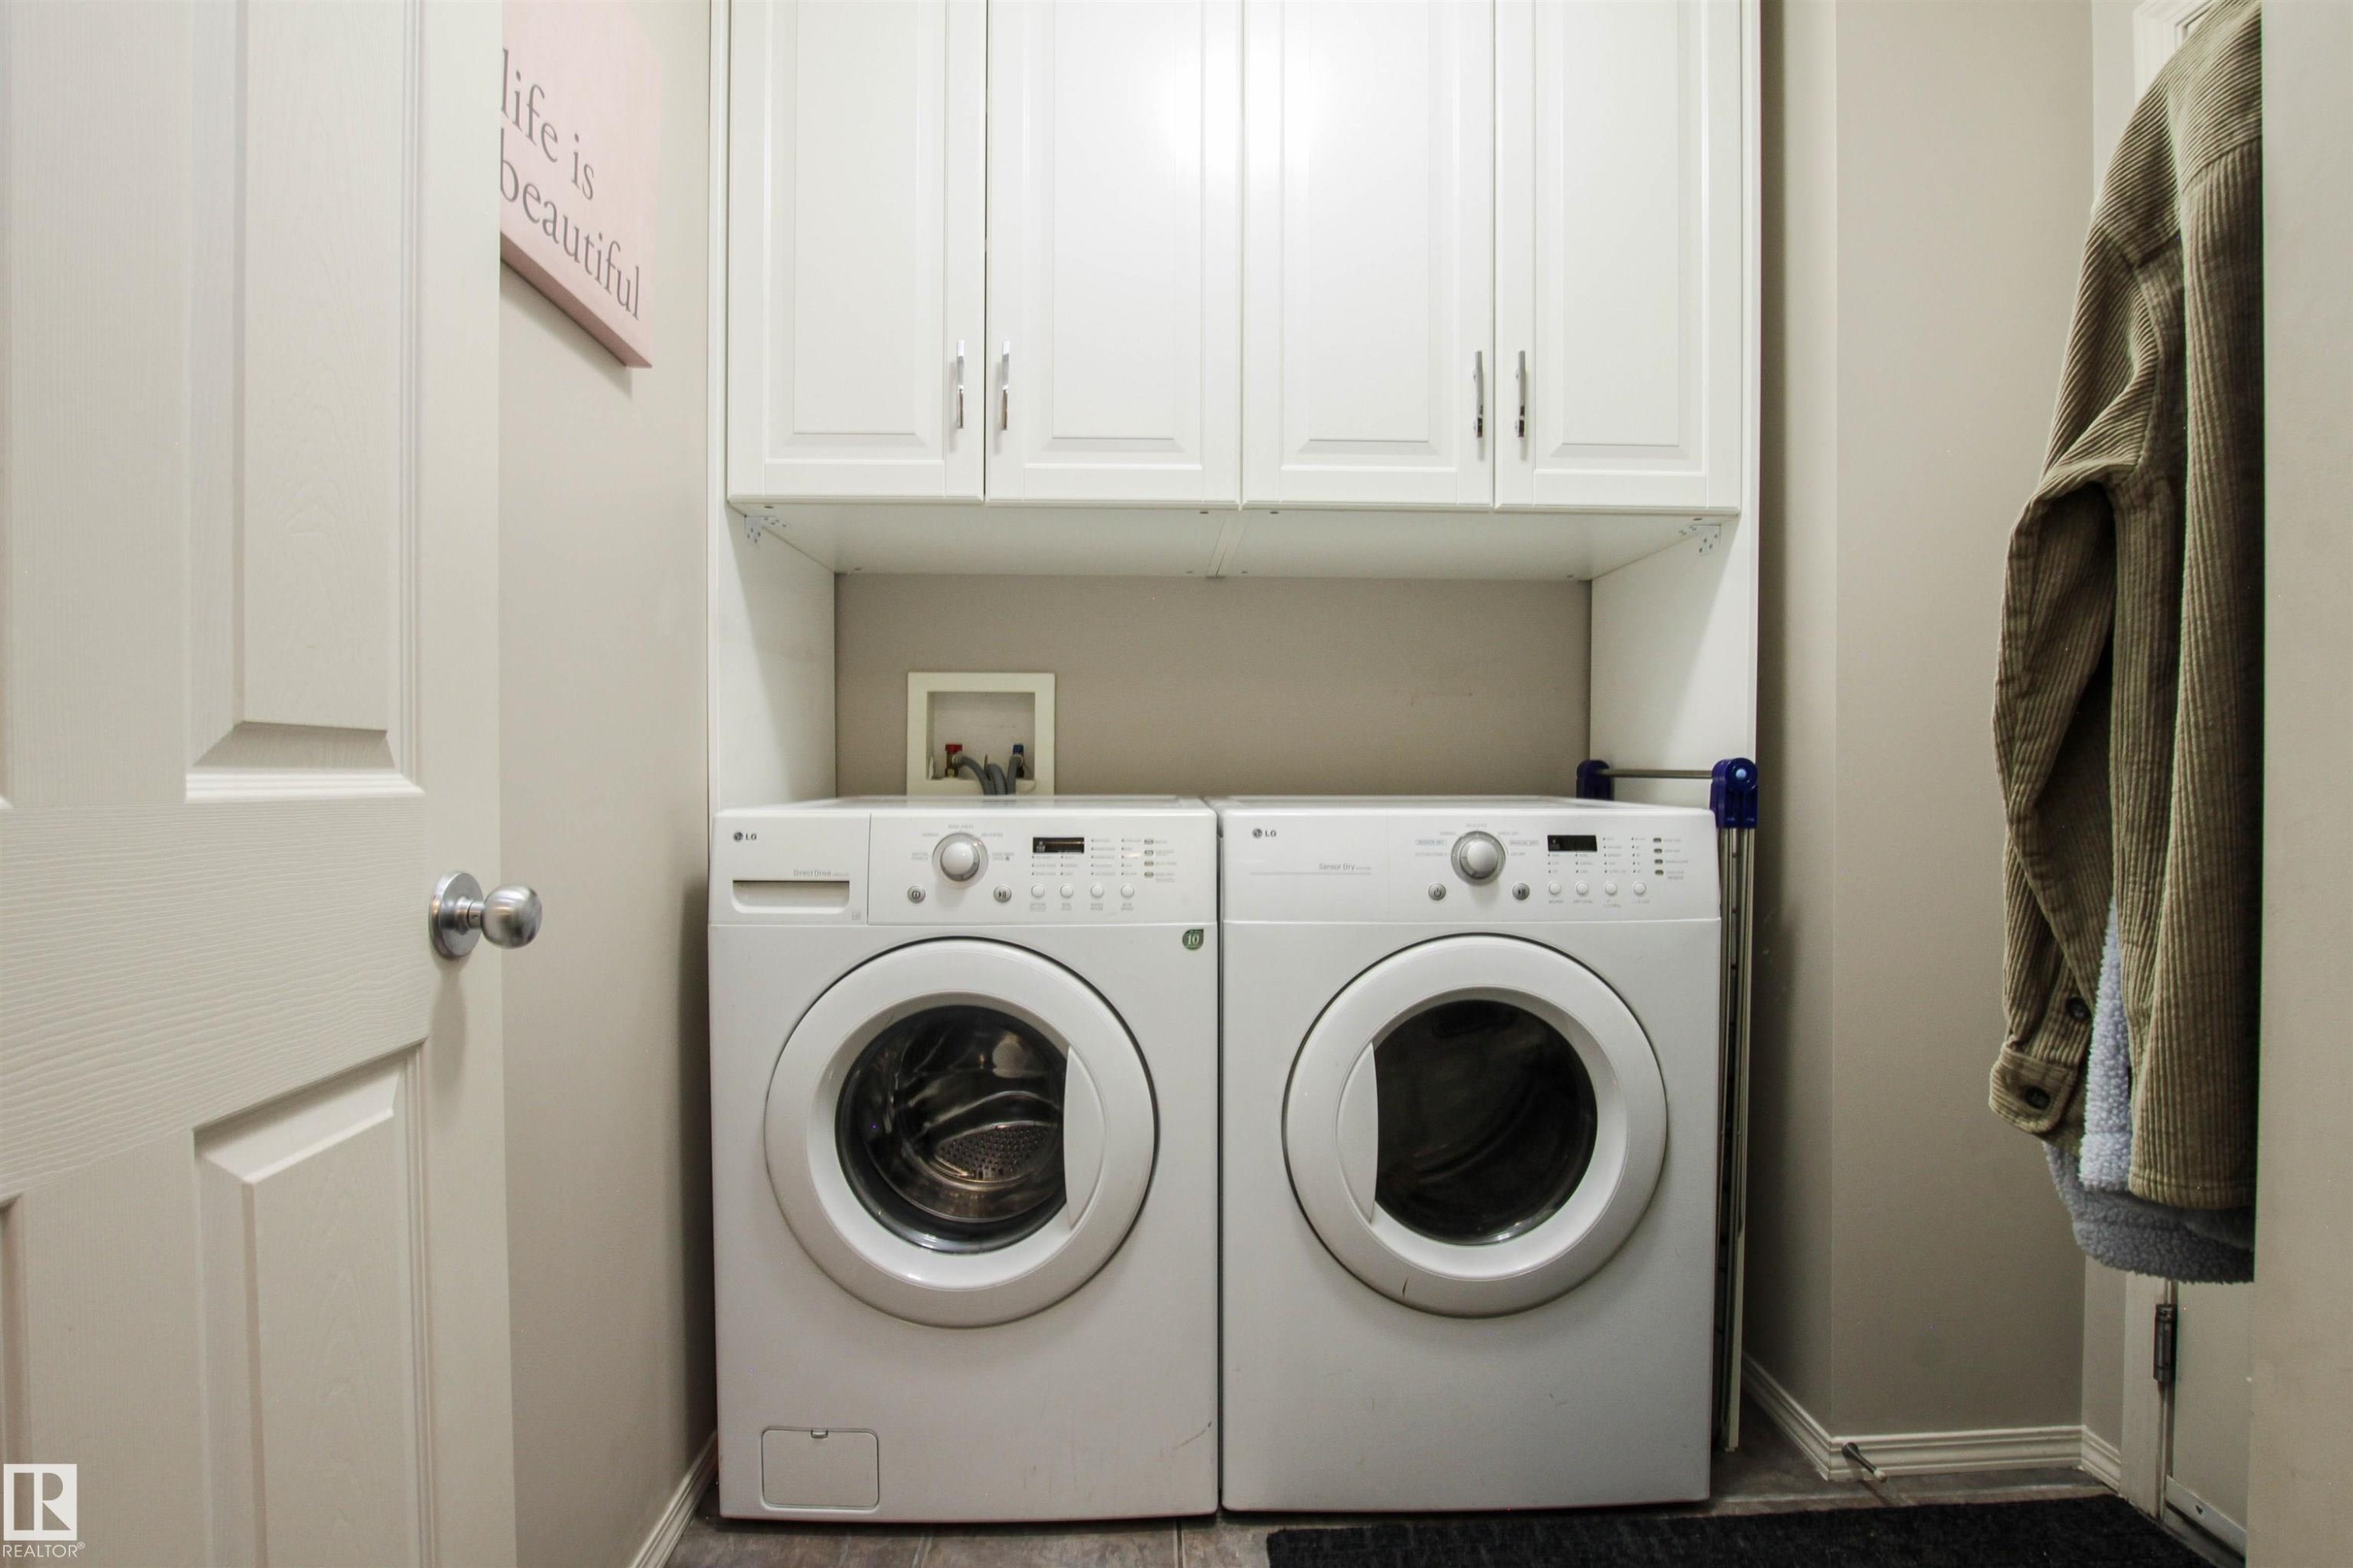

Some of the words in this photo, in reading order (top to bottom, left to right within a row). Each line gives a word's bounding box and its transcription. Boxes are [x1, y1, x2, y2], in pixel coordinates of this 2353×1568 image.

[501, 48, 558, 162] life
[570, 133, 595, 201] is
[500, 128, 639, 320] beautiful
[1343, 863, 1355, 871] Dry
[1187, 933, 1200, 945] 10
